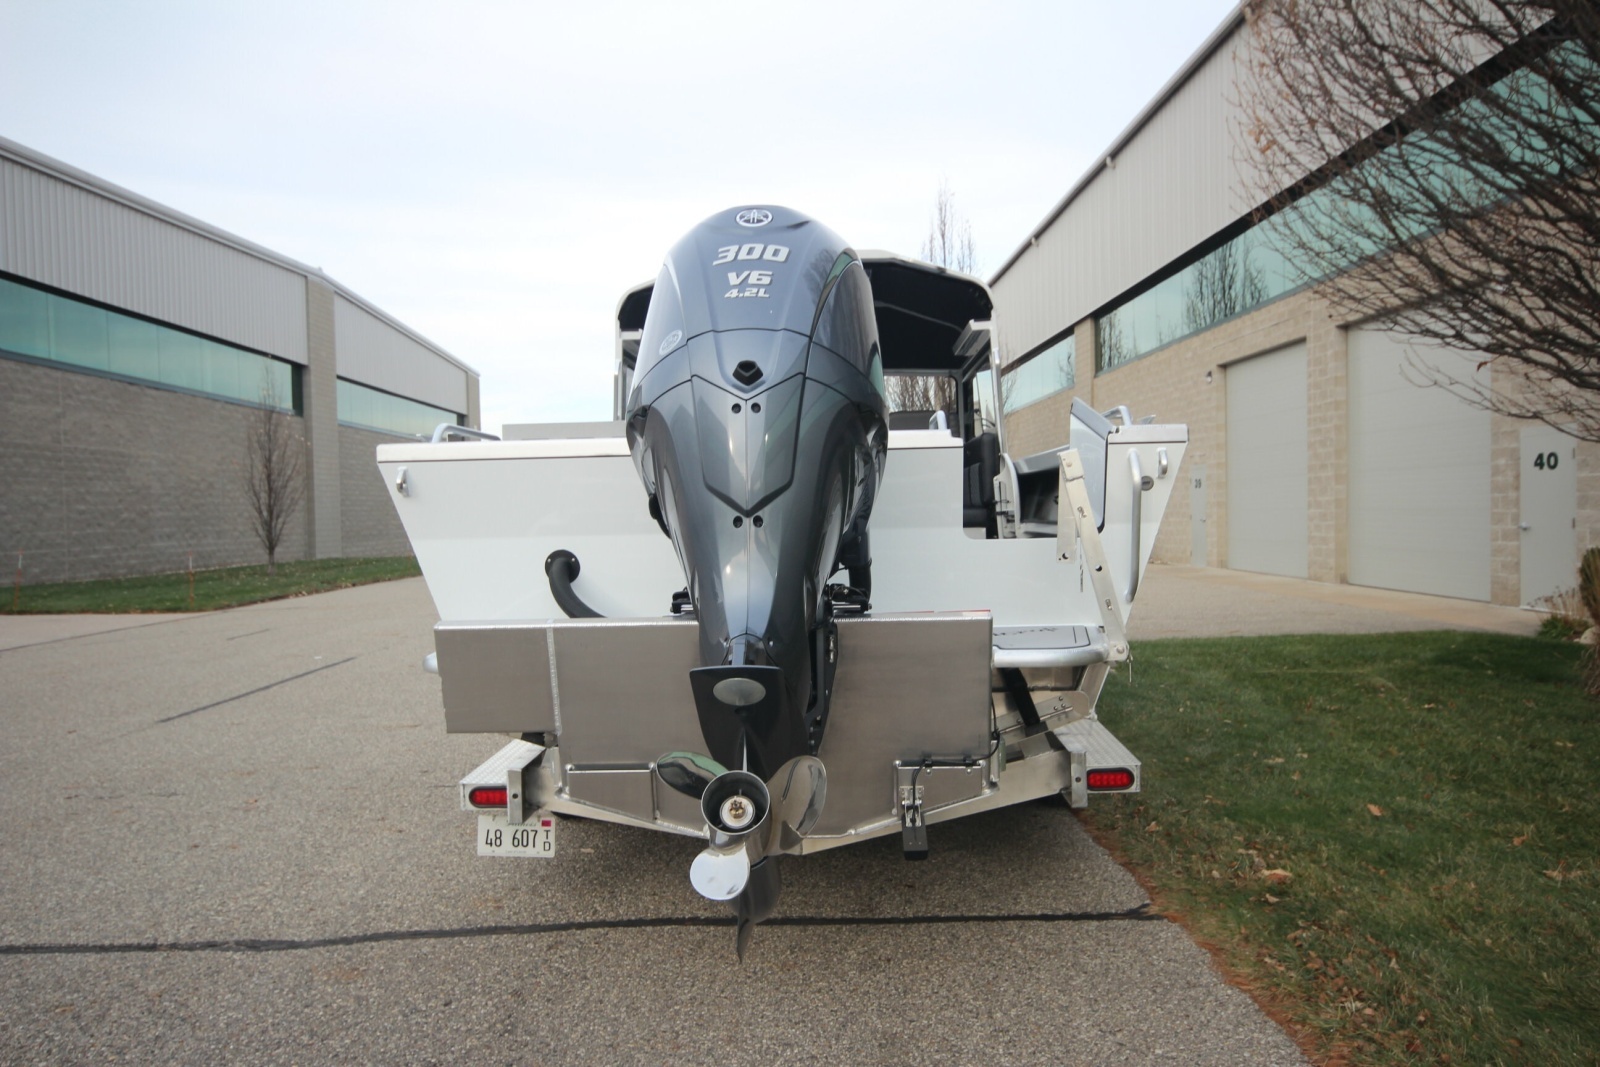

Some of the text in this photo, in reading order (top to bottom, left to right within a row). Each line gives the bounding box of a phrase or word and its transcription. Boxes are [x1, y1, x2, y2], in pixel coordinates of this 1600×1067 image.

[712, 243, 790, 266] 300
[727, 270, 773, 286] V6
[724, 287, 770, 298] 4.2L
[1533, 451, 1559, 470] 40
[485, 829, 538, 848] 48 607
